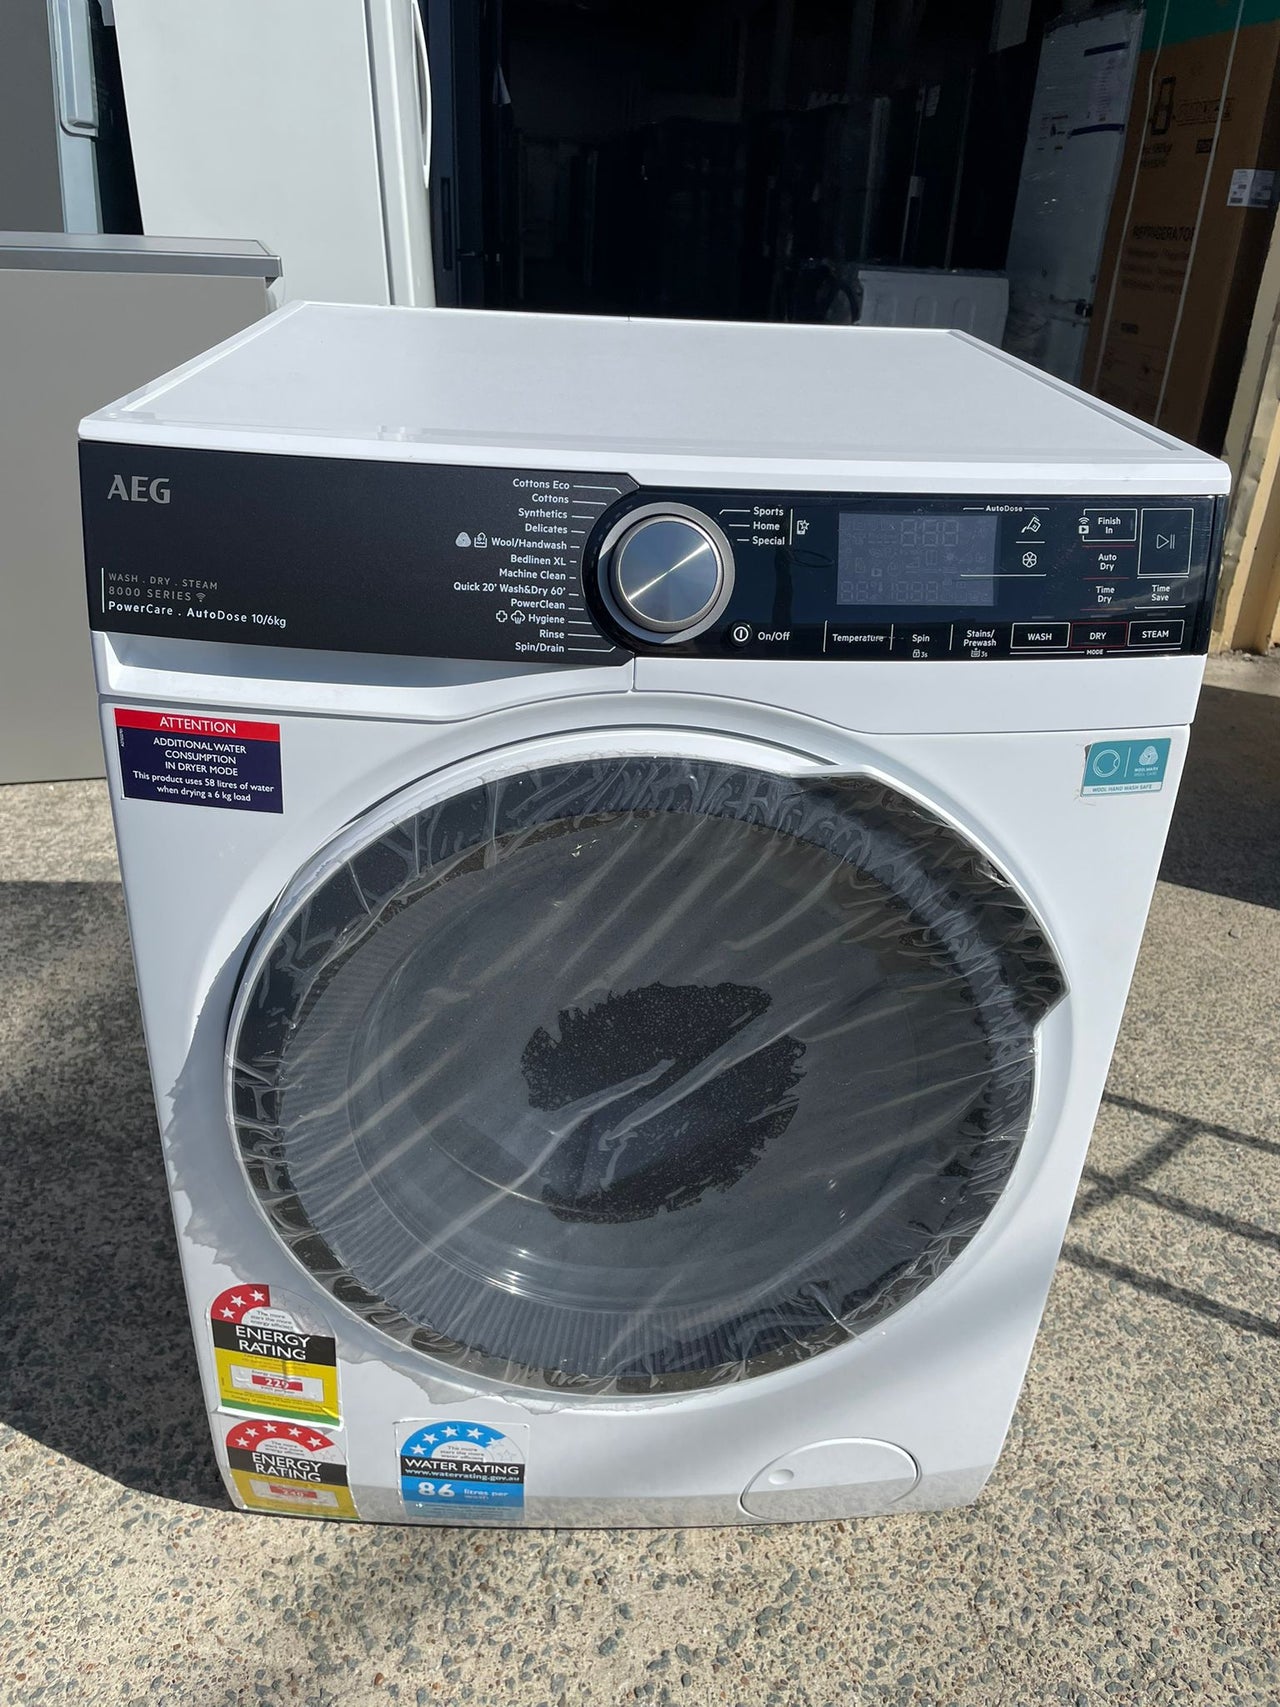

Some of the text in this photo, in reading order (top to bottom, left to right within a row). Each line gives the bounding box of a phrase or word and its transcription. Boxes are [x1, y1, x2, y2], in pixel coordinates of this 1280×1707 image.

[107, 474, 170, 504] AEG
[512, 479, 570, 490] Cottons Eco
[532, 494, 569, 503] Cottons
[518, 508, 568, 519] Synthetics
[754, 507, 784, 516] Sports
[753, 522, 780, 530] Home
[1098, 517, 1121, 525] Finish
[525, 524, 568, 534] Delicates
[492, 537, 567, 550] Wool/Handwash
[752, 536, 785, 546] Special
[510, 555, 566, 566] Bedlinen XL
[1098, 554, 1117, 562] Auto
[1100, 562, 1114, 572] Dry
[499, 568, 566, 580] Machine Clean
[109, 572, 218, 590] WASH DRY STEAM
[108, 586, 192, 601] 8000 SERIES
[454, 582, 480, 591] Quick
[500, 585, 548, 596] Wash&Dry
[1096, 586, 1115, 594] Time
[1152, 585, 1170, 593] Time
[510, 599, 565, 610] PowerClean
[1097, 595, 1112, 604] Dry
[108, 601, 287, 629] PowerCare AutoDose 10/6kg
[528, 614, 565, 625] Hygiene
[539, 629, 564, 638] Rinse
[758, 631, 790, 641] On/Off
[832, 634, 884, 643] Temperature
[912, 634, 930, 643] Spin
[966, 629, 995, 639] Stains/
[1027, 632, 1052, 641] WASH
[1089, 631, 1106, 640] DRY
[1142, 630, 1170, 638] STEAM
[515, 642, 564, 653] Spin/Drain
[964, 638, 997, 647] Prewash
[160, 716, 236, 734] ATTENTION
[153, 737, 247, 754] ADDITIONAL WATER
[165, 750, 236, 764] CONSUMPTION
[165, 761, 238, 776] IN DRYER MODE
[133, 770, 150, 780] This
[152, 774, 183, 784] product
[204, 778, 215, 786] 58
[217, 780, 237, 790] litres
[239, 782, 248, 790] of
[250, 784, 274, 792] water
[156, 785, 178, 795] when
[181, 788, 206, 799] drying
[222, 791, 231, 801] kg
[234, 793, 251, 802] load
[235, 1325, 310, 1348] ENERGY
[238, 1340, 306, 1360] RATING
[265, 1379, 289, 1389] 229
[252, 1452, 321, 1472] ENERGY
[405, 1458, 519, 1475] WATER RATING
[256, 1464, 321, 1482] RATING
[405, 1469, 520, 1482] www.waterrating.gov.au
[418, 1482, 455, 1498] 86
